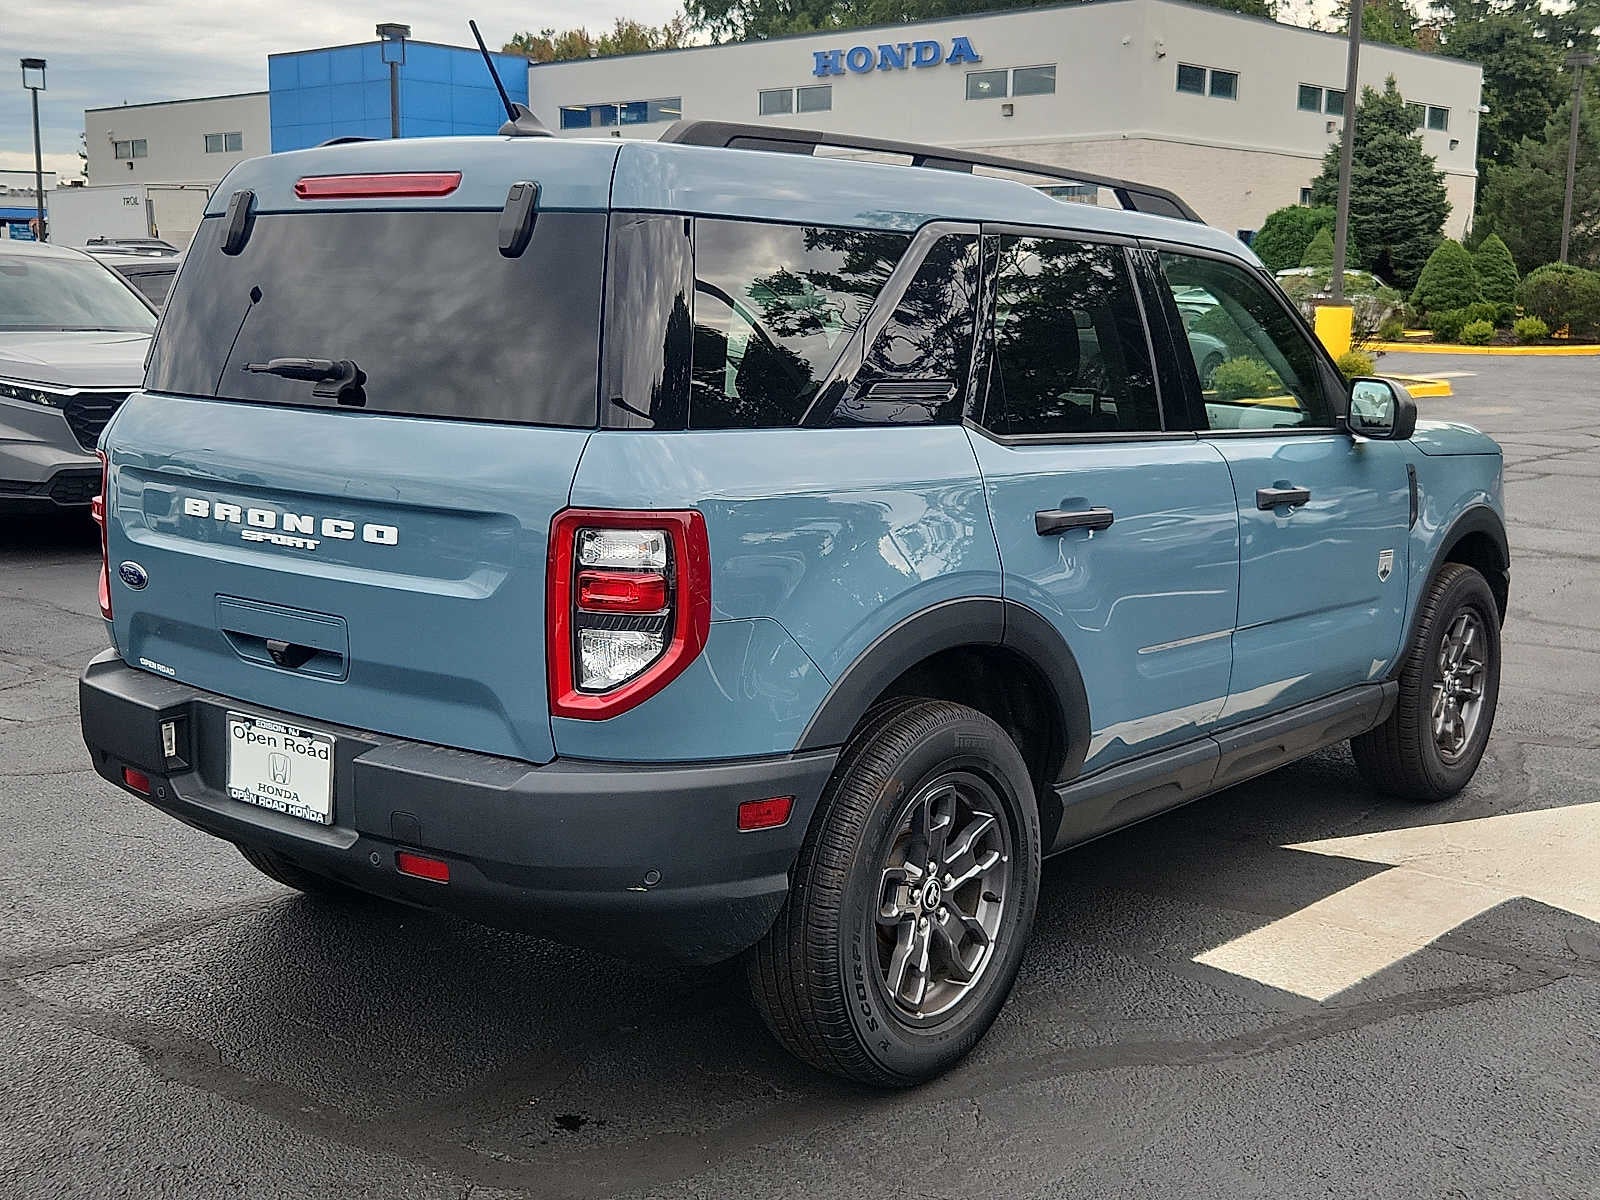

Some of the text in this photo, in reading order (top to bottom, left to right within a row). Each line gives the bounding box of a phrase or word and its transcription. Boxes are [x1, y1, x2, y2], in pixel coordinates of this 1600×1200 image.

[812, 36, 981, 76] HONDA
[184, 497, 398, 545] BRONCO
[241, 529, 321, 550] SPORT
[139, 658, 176, 676] OPEN ROAD
[233, 725, 329, 760] Open Road
[288, 727, 300, 736] NJ
[231, 788, 324, 824] OPEN ROAD HONDA
[258, 783, 301, 802] HONDA
